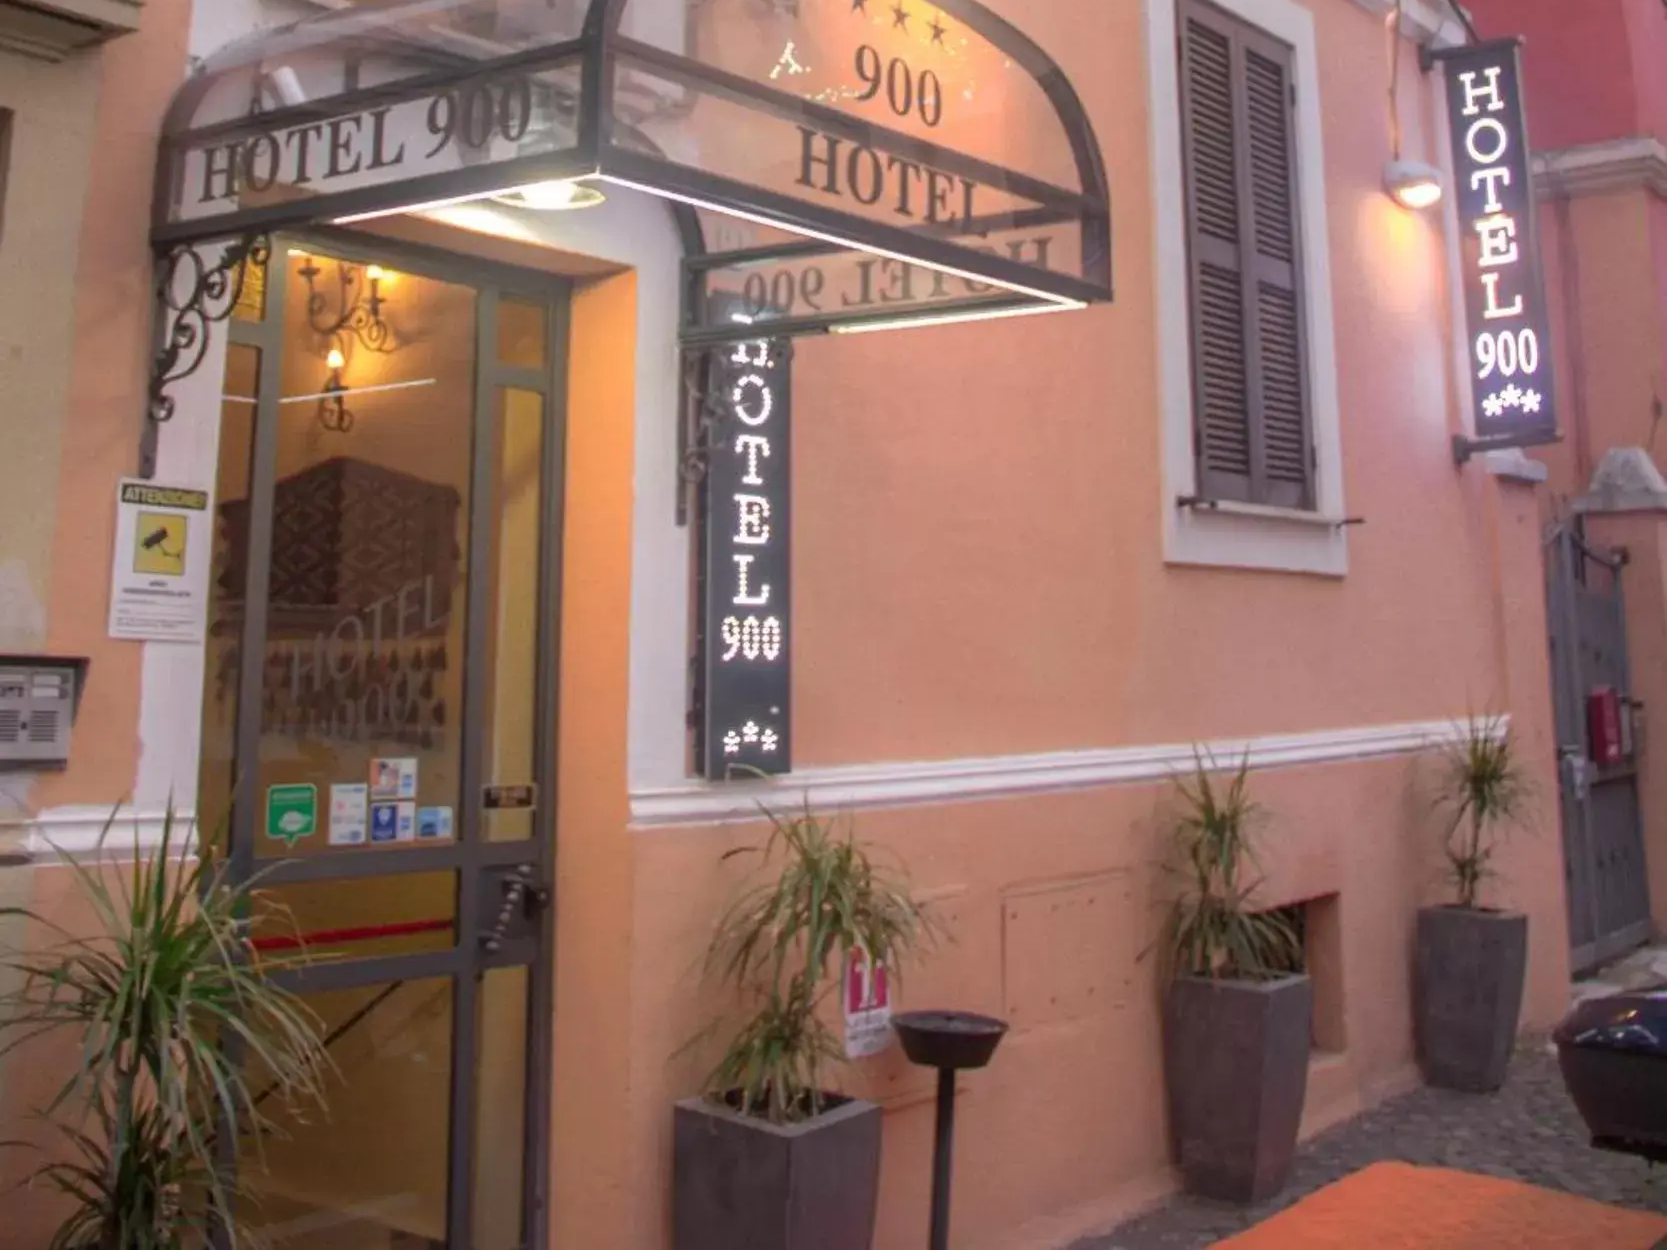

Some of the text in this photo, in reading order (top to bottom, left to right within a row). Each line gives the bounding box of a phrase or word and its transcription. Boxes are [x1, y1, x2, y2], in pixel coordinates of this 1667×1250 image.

[854, 45, 941, 127] 900
[198, 75, 531, 203] HOTEL 900
[795, 127, 988, 239] HOTEL
[1459, 66, 1523, 319] HOTEL
[1477, 327, 1538, 380] 900
[722, 615, 780, 661] 900
